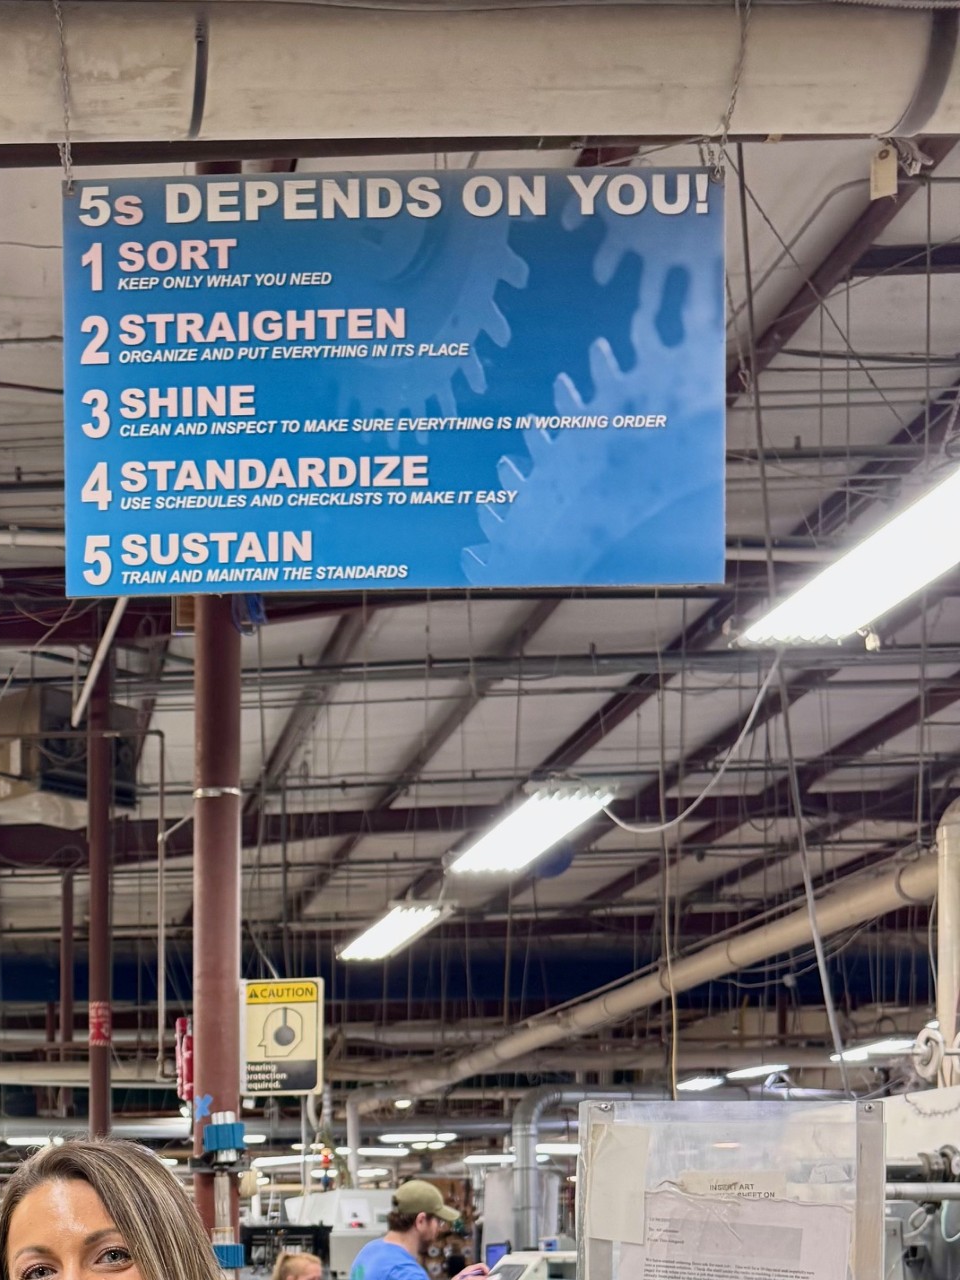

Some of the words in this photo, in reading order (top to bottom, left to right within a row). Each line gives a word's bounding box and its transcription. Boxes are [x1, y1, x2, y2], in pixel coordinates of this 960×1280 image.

[78, 185, 144, 227] 5s
[165, 176, 442, 224] DEPENDS
[462, 175, 547, 217] ON
[567, 173, 709, 215] YOU!
[81, 242, 103, 291] 1
[118, 238, 237, 273] SORT
[117, 277, 159, 291] KEEP
[162, 275, 204, 289] ONLY
[206, 274, 251, 288] WHAT
[254, 273, 286, 287] YOU
[290, 272, 332, 286] NEED
[80, 315, 110, 365] 2
[119, 308, 405, 346] STRAIGHTEN
[119, 349, 197, 364] ORGANIZE
[200, 348, 234, 362] AND
[237, 347, 269, 361] PUT
[271, 345, 369, 360] EVERYTHING
[371, 344, 387, 358] IN
[390, 343, 415, 357] ITS
[417, 342, 470, 357] PLACE
[81, 389, 110, 439] 3
[119, 385, 256, 420] SHINE
[119, 424, 172, 438] CLEAN
[174, 422, 208, 436] AND
[210, 420, 277, 435] INSPECT
[280, 420, 300, 433] TO
[303, 419, 349, 433] MAKE
[352, 418, 394, 432] SURE
[397, 416, 494, 431] EVERYTHING
[496, 416, 512, 429] IS
[515, 416, 532, 429] IN
[534, 415, 609, 429] WORKING
[612, 414, 667, 428] ORDER
[81, 461, 112, 511] 4
[120, 455, 429, 493] STANDARDIZE
[120, 497, 151, 510] USE
[155, 495, 247, 509] SCHEDULES
[250, 494, 285, 508] AND
[287, 492, 383, 507] CHECKLISTS
[386, 492, 407, 505] TO
[409, 491, 455, 504] MAKE
[457, 490, 473, 504] IT
[475, 490, 518, 504] EASY
[82, 535, 112, 586] 5
[120, 530, 312, 566] SUSTAIN
[121, 571, 167, 585] TRAIN
[169, 570, 203, 583] AND
[206, 568, 278, 583] MAINTAIN
[283, 567, 313, 581] THE
[316, 565, 408, 580] STANDARDS
[260, 987, 314, 998] CAUTION
[246, 1080, 281, 1090] equired.
